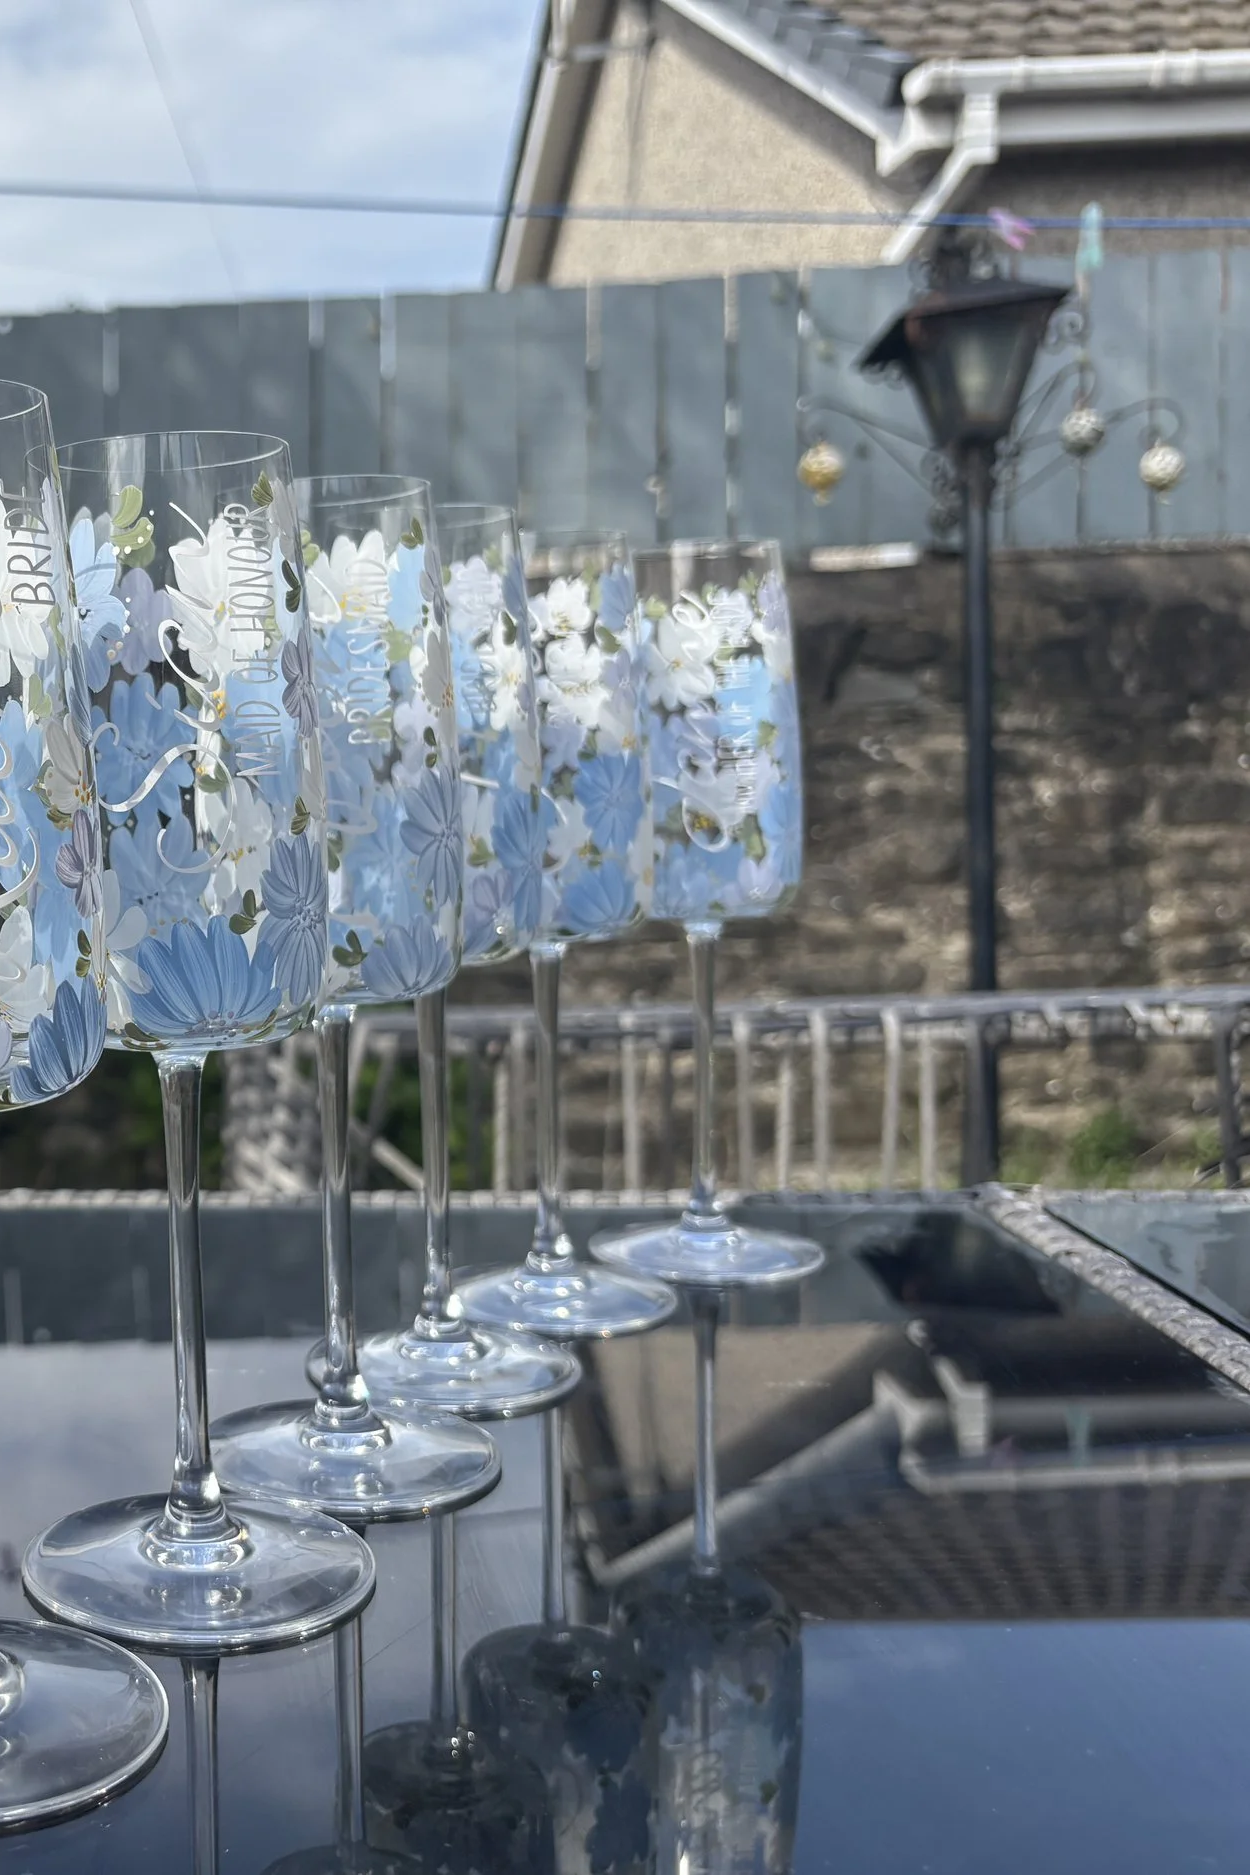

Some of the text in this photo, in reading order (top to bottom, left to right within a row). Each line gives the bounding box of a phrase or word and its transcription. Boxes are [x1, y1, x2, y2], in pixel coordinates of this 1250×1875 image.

[224, 503, 281, 776] MAID OF HONOUR
